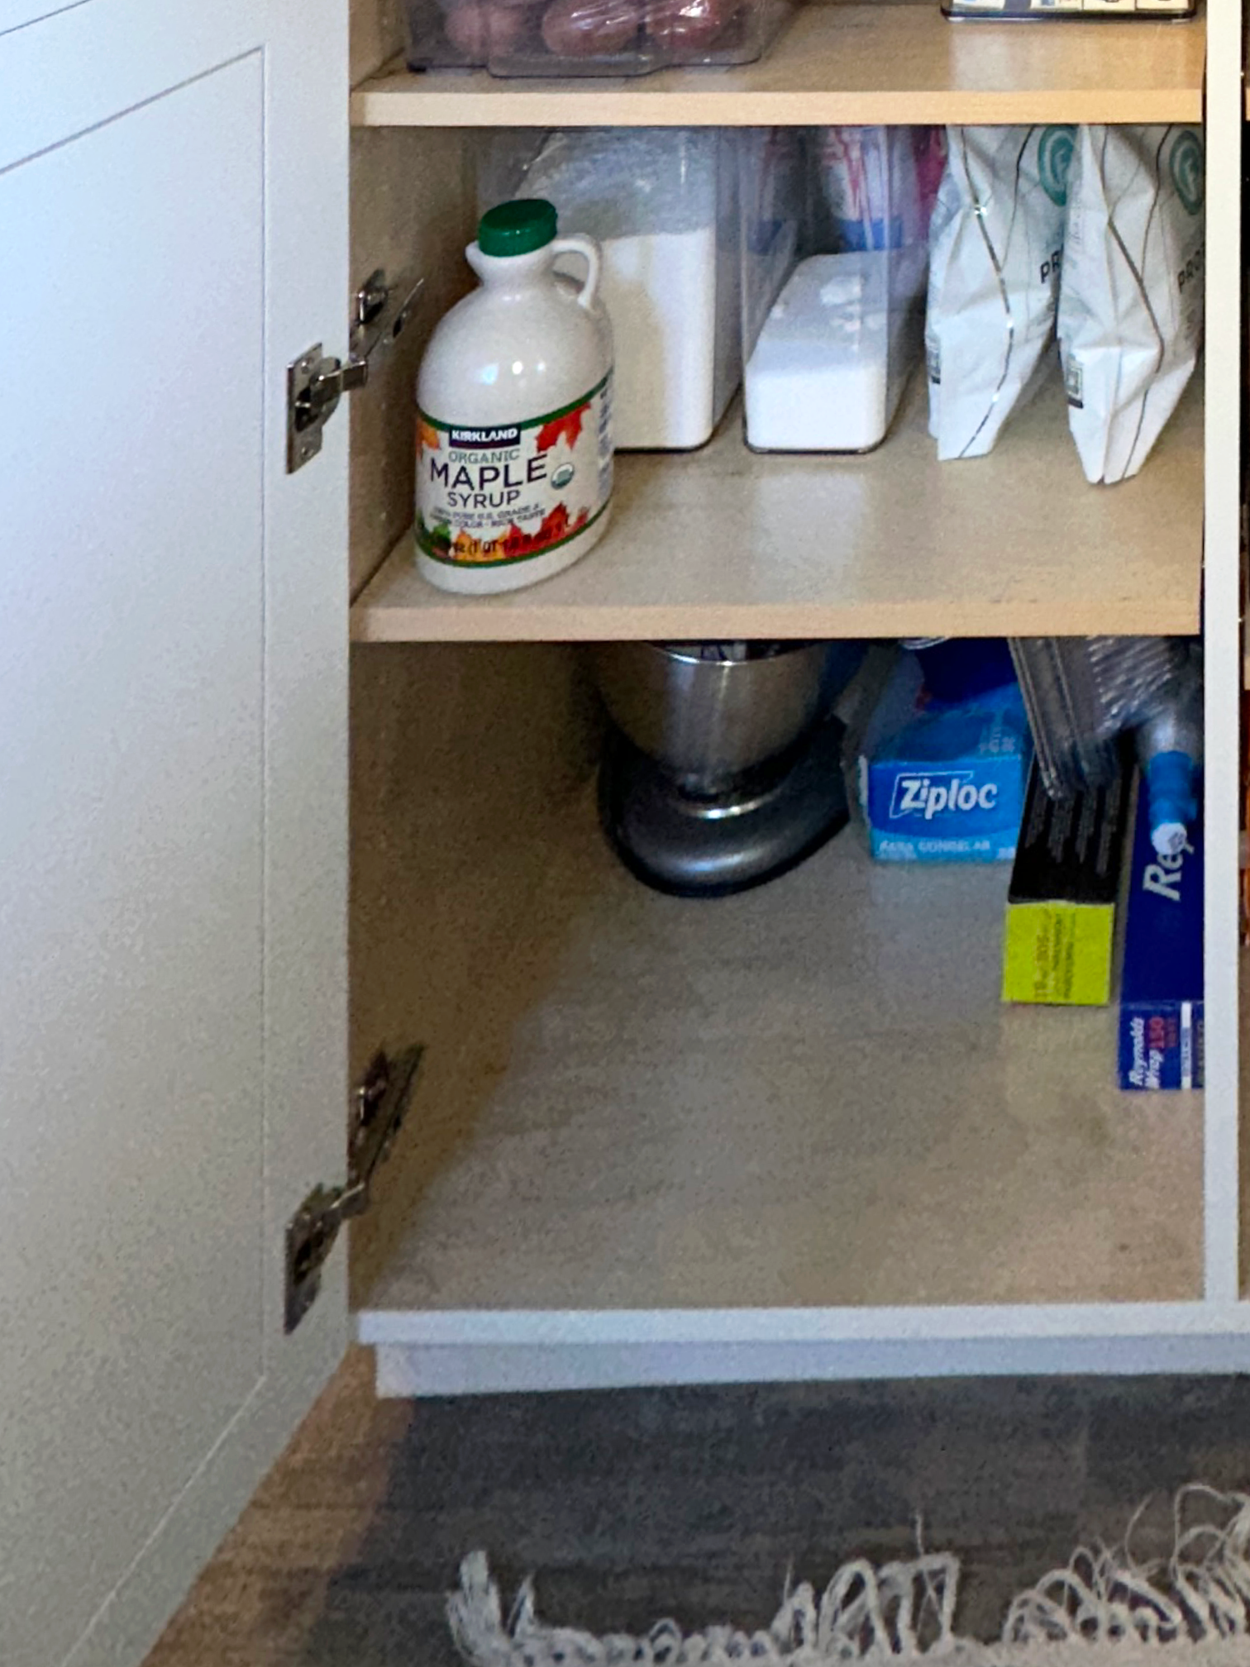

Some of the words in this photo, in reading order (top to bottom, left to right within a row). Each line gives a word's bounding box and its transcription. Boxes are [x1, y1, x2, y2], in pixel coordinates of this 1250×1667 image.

[451, 427, 518, 442] KIRKLAND
[448, 448, 521, 465] ORGANIC
[430, 453, 548, 492] MAPLE
[447, 489, 521, 509] SYRUP
[453, 511, 476, 519] PURE
[497, 504, 532, 519] GRADE
[453, 519, 484, 529] COLOR
[516, 508, 546, 523] TASTE
[900, 777, 998, 820] Ziploc
[1150, 1015, 1165, 1049] 150
[1128, 1015, 1147, 1086] Reynolds
[1145, 1048, 1164, 1090] Wrap
